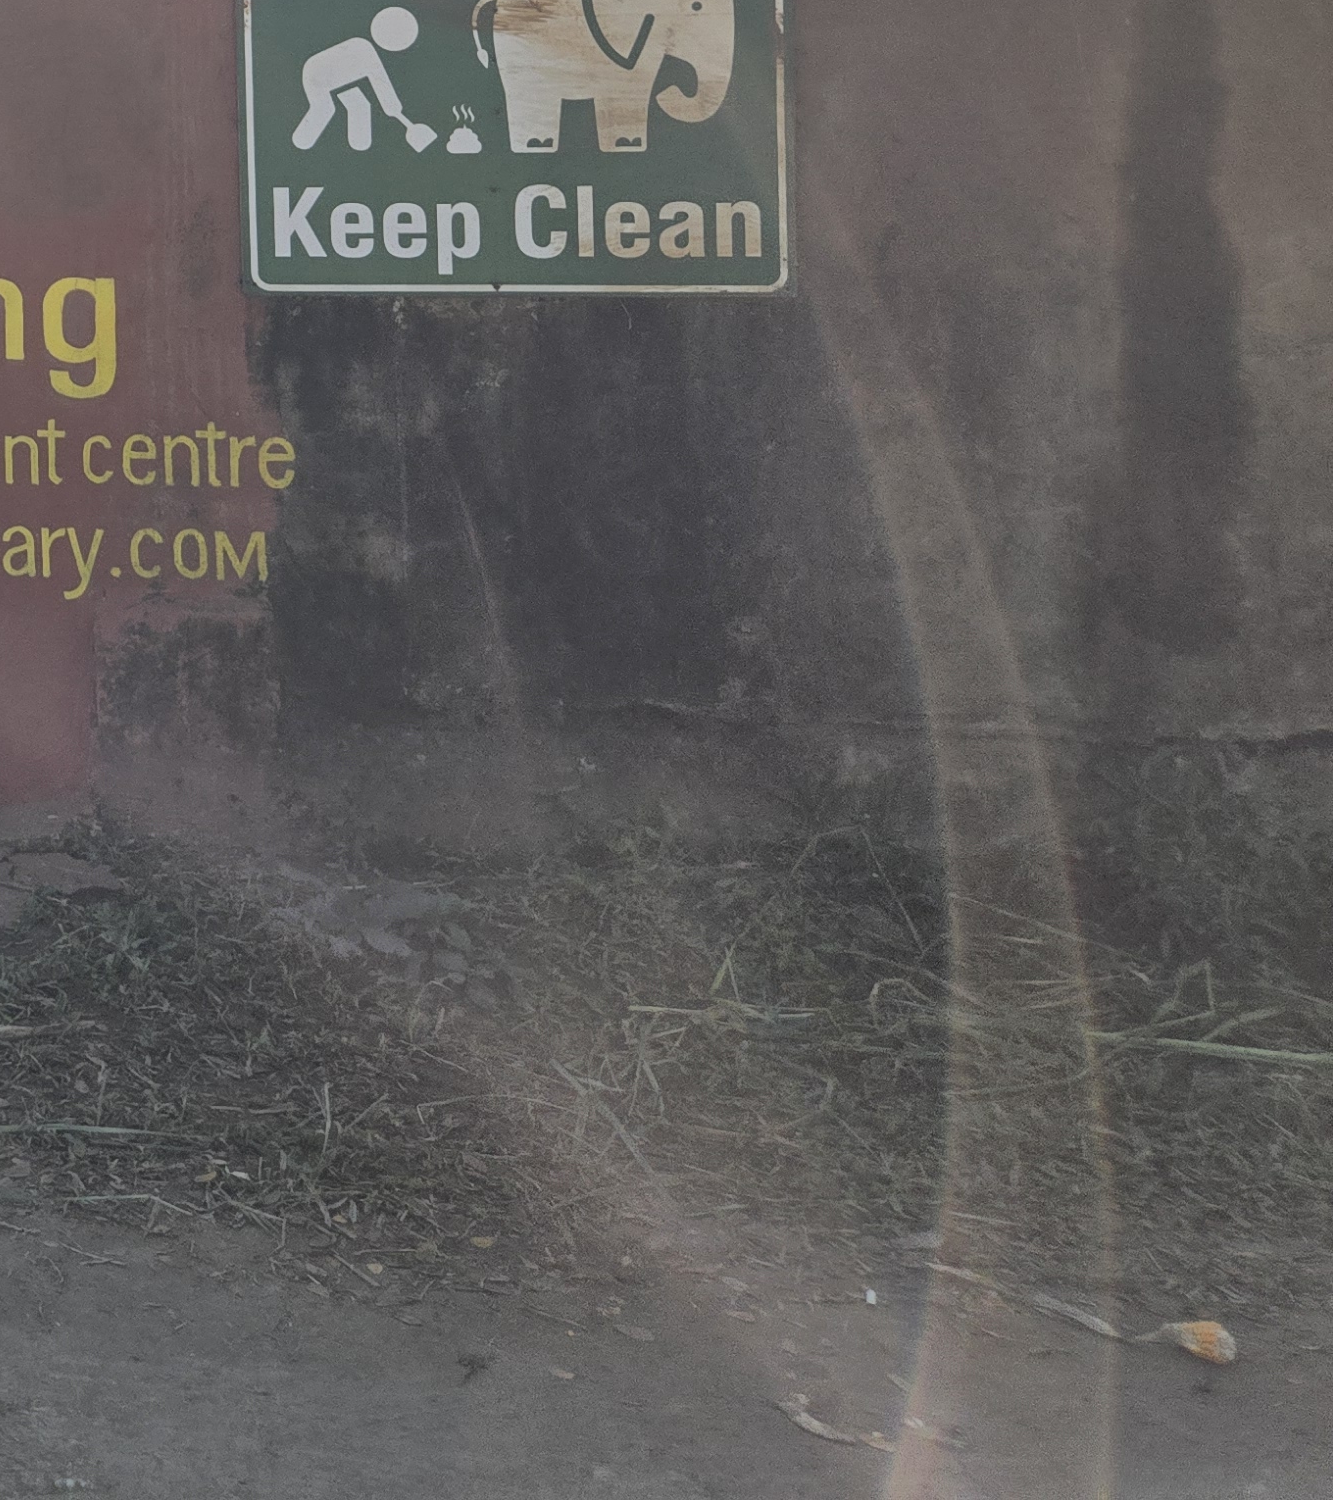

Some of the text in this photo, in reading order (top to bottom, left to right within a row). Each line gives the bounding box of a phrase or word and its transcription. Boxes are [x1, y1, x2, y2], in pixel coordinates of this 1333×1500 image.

[271, 183, 763, 276] Keep Clean
[81, 421, 297, 489] centre
